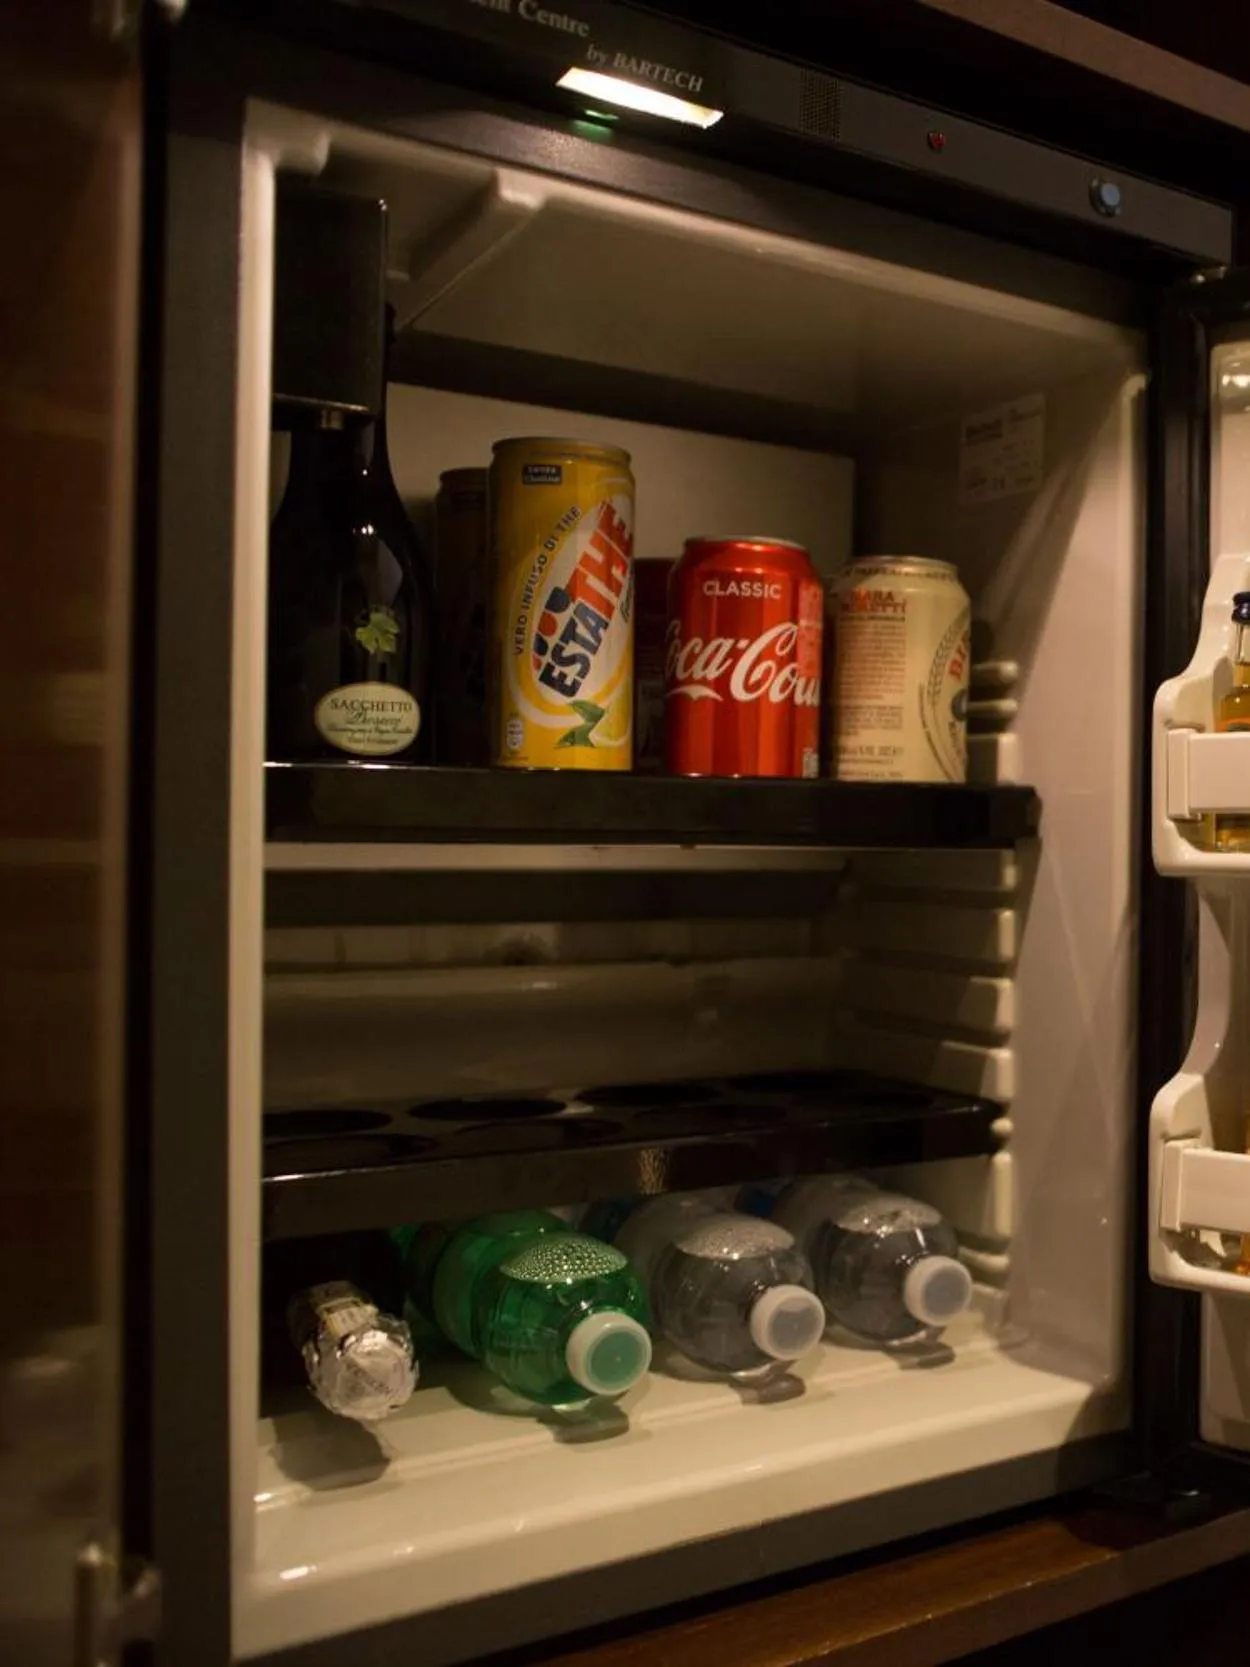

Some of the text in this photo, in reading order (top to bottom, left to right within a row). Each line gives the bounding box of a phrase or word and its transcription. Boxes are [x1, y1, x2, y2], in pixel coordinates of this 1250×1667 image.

[518, 0, 590, 37] Centre
[586, 43, 703, 92] by BARTECH
[513, 614, 529, 656] VERO
[521, 554, 548, 611] INFUSO
[543, 534, 560, 552] DI
[703, 580, 782, 599] CLASSIC
[666, 619, 820, 707] oca-Co
[330, 698, 413, 713] SACCHETTO
